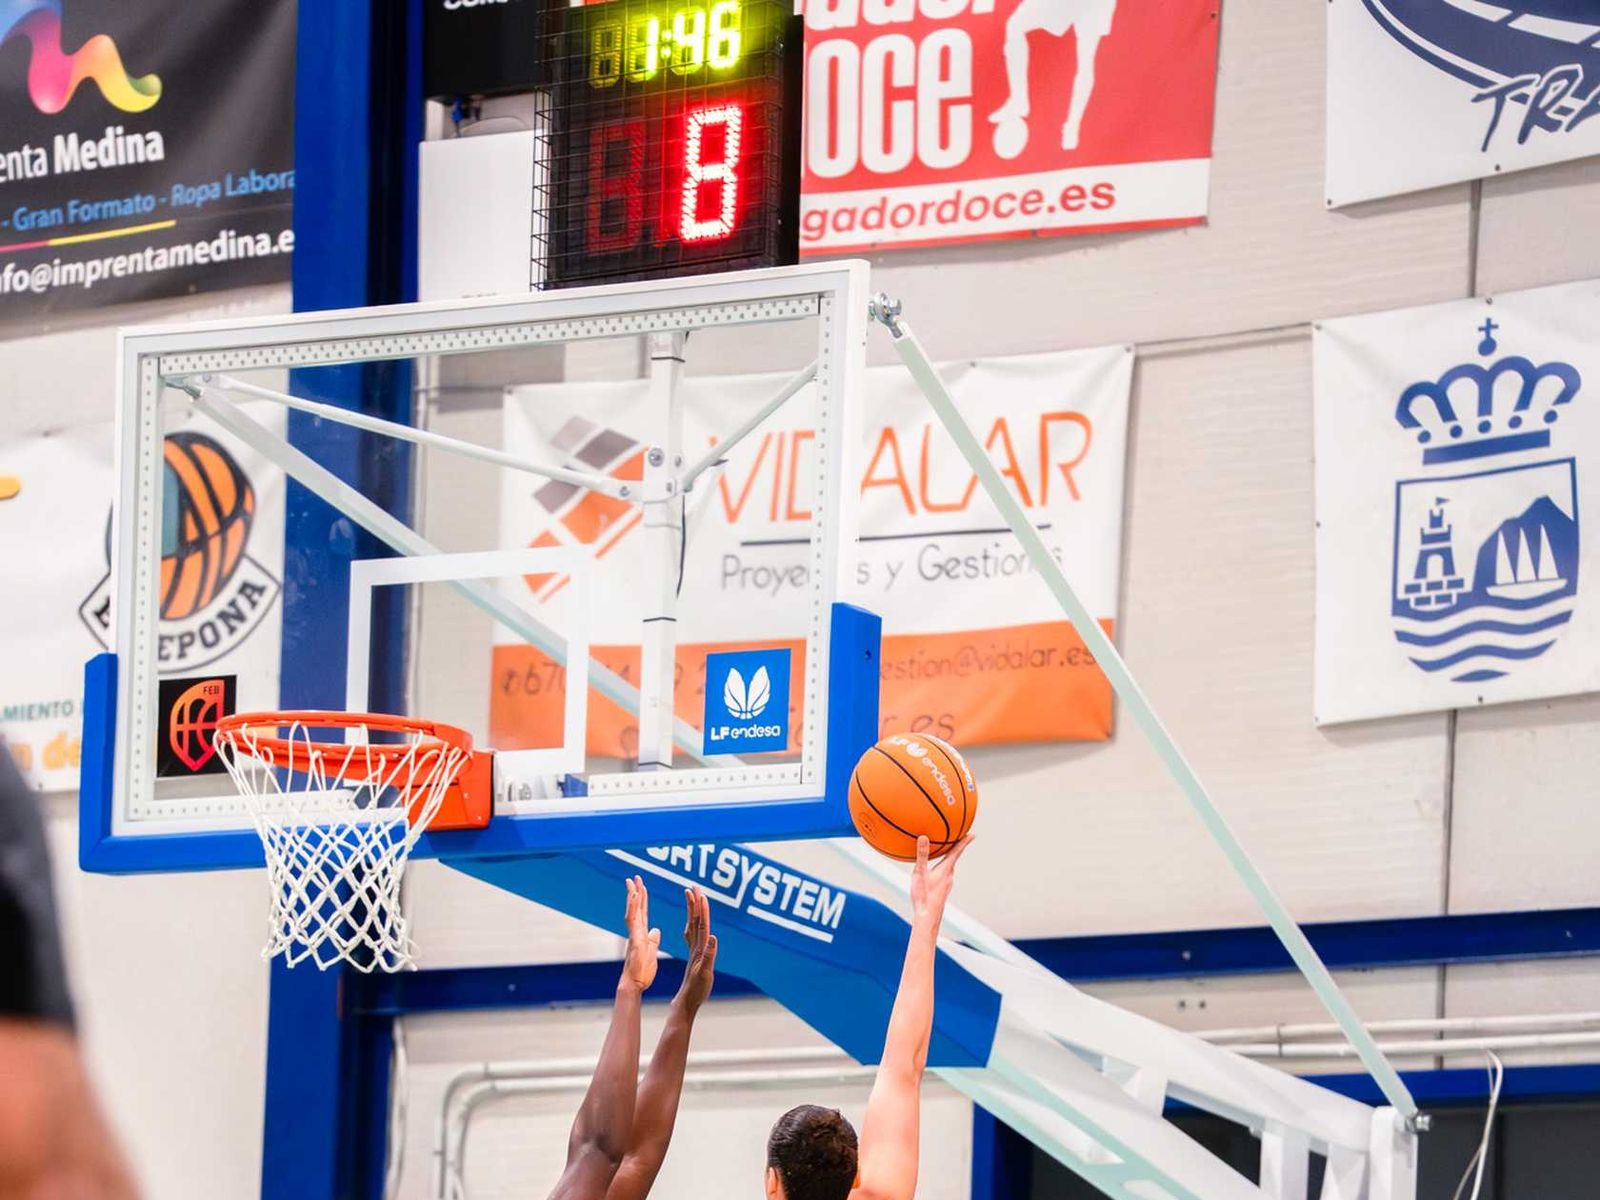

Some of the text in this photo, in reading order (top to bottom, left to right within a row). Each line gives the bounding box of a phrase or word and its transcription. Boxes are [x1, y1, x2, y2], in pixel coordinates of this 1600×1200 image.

[645, 1, 742, 81] 1:46
[54, 125, 165, 174] Medina
[680, 104, 742, 241] 8
[13, 206, 63, 231] Gran
[67, 194, 156, 223] Formato
[171, 182, 221, 207] Ropa
[0, 229, 295, 294] fo@imprentamedina.e
[917, 543, 1064, 582] Gestions
[880, 639, 1098, 682] estion@vidalar.es
[0, 700, 74, 721] MIENTO
[711, 724, 781, 740] LF endesa
